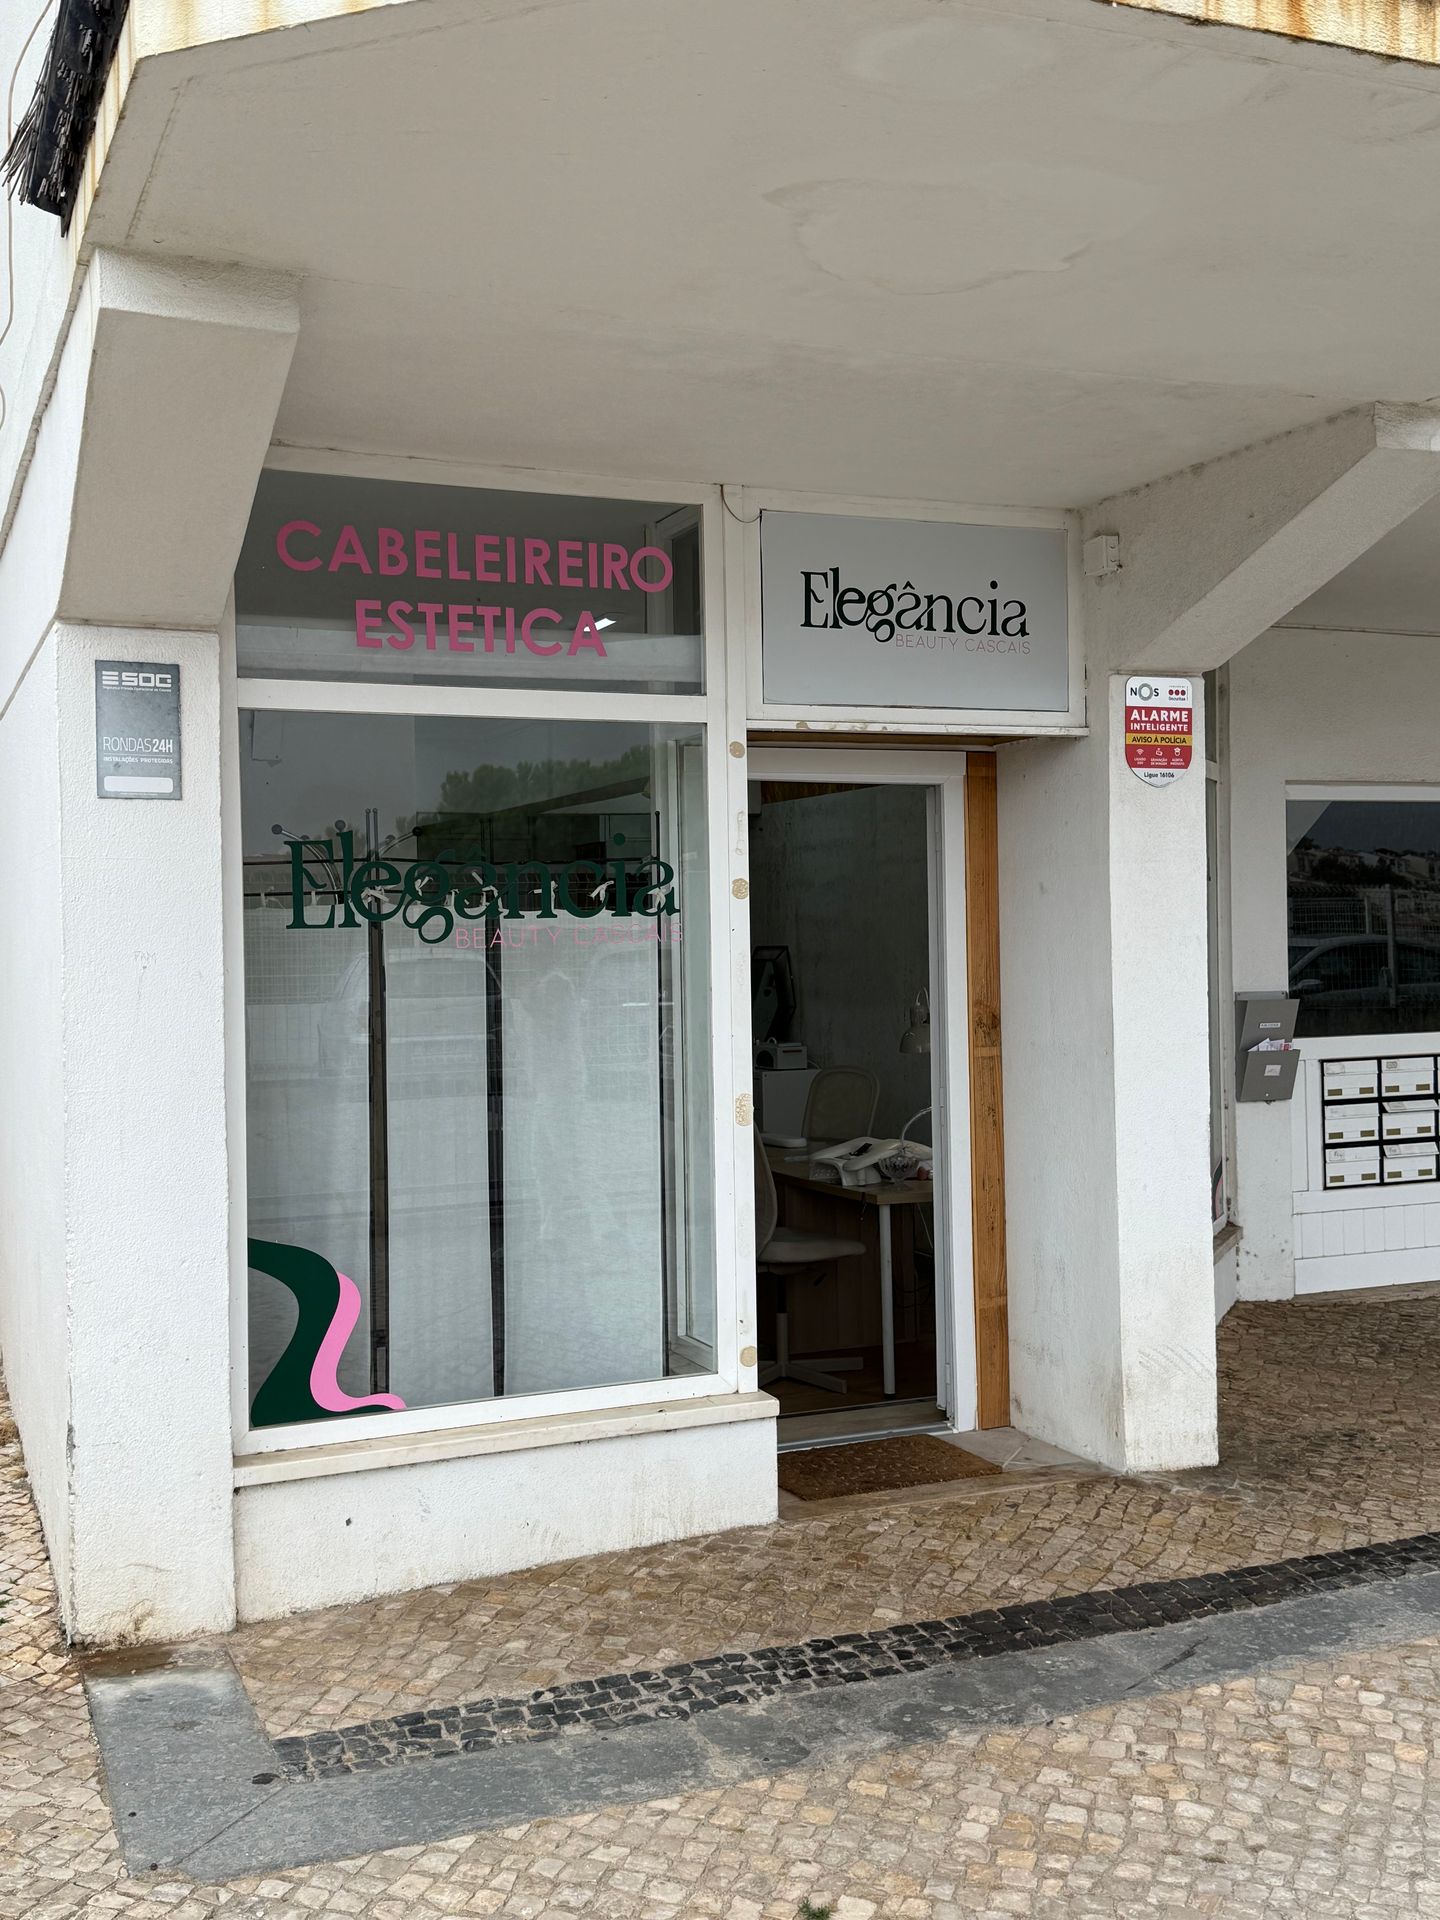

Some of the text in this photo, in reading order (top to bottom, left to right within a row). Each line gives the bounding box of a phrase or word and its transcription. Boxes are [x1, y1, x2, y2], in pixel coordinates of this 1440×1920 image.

[276, 520, 673, 593] CABELEIREIRO
[800, 567, 1030, 642] Elegância
[355, 600, 608, 657] ESTETICA
[895, 634, 1031, 655] BEAUTY CASCAIS
[1130, 683, 1159, 701] NOS
[1130, 709, 1189, 722] ALARME
[1130, 723, 1189, 732] INTELIGENTE
[1132, 736, 1152, 744] AVISO
[1160, 736, 1187, 744] POLÍCIA
[456, 922, 683, 949] BEAUTY CASCAIS
